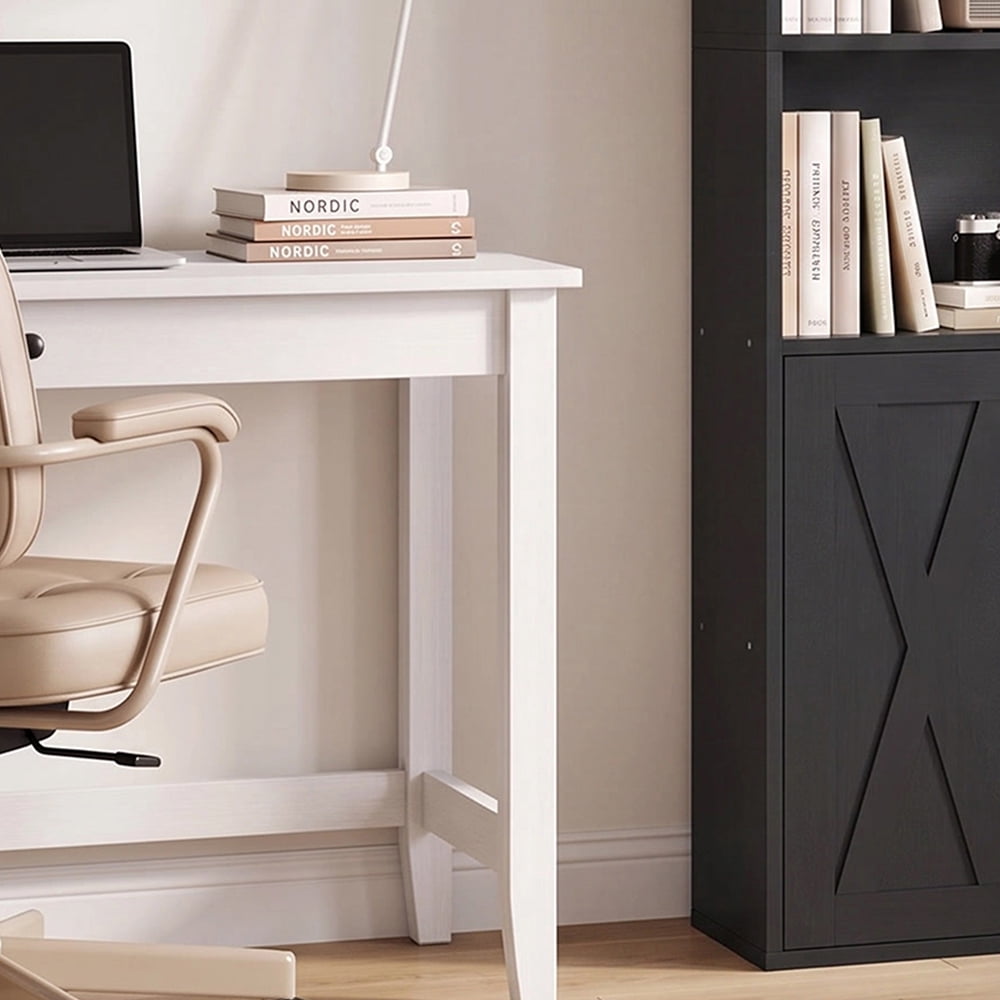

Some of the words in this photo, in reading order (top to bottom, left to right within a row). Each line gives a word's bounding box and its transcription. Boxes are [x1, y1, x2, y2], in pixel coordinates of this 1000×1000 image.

[289, 198, 361, 214] NORDIC
[281, 223, 337, 237] NORDIC
[450, 221, 462, 234] S
[269, 244, 330, 259] NORDIC
